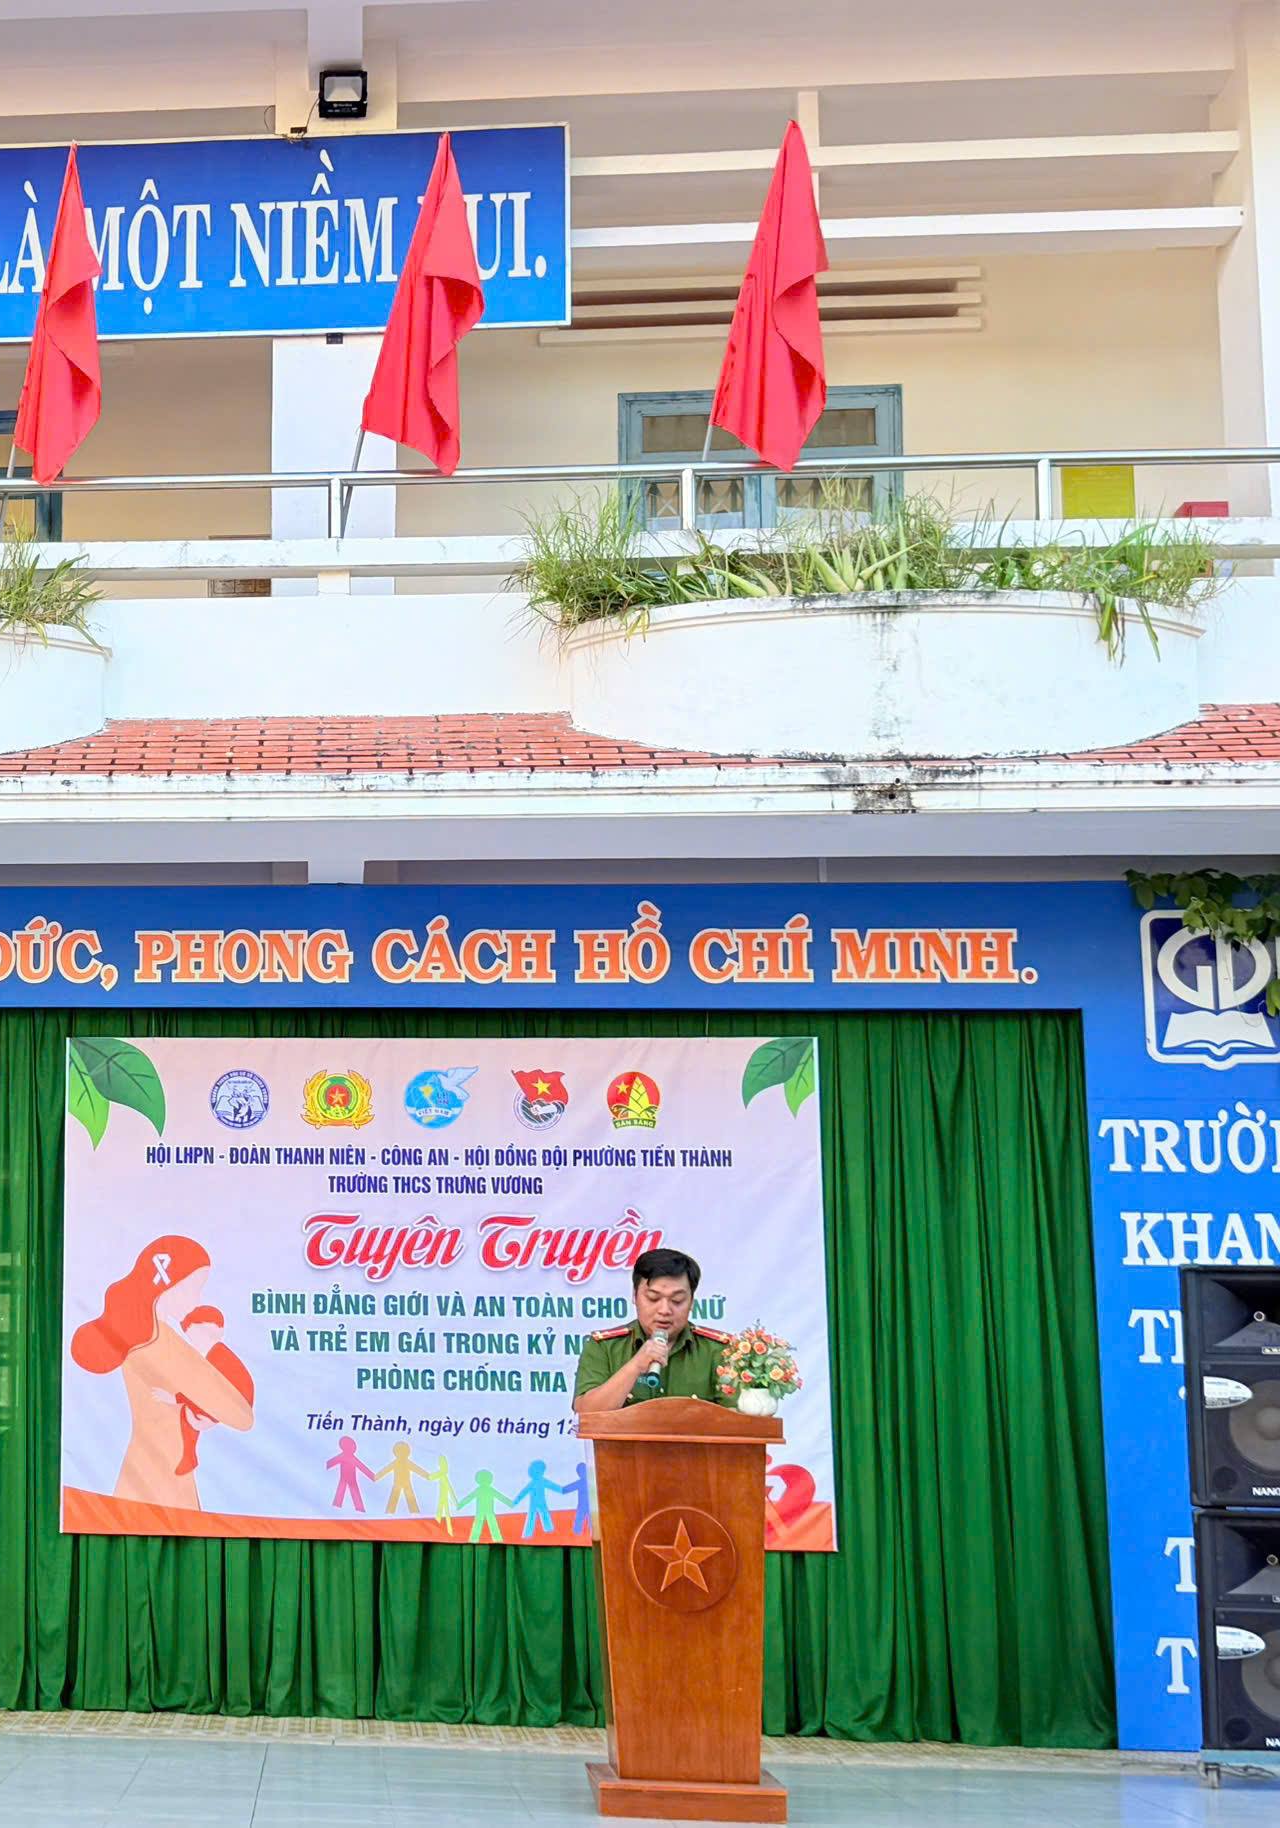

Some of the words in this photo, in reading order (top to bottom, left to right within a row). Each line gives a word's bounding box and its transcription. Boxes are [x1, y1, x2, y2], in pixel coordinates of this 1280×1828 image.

[229, 149, 398, 288] NIỀM
[417, 191, 547, 281] UI.
[134, 929, 354, 984] PHONG
[371, 914, 556, 984] CÁCH
[573, 900, 671, 985] HỒ
[688, 913, 814, 984] CHÍ
[830, 928, 1038, 984] MINH.
[146, 1143, 170, 1167] HỘI
[176, 1147, 214, 1165] LHPN
[229, 1144, 270, 1165] ĐOÀN
[275, 1147, 324, 1165] THANH
[329, 1143, 366, 1165] NIÊN
[381, 1145, 423, 1166] CÔNG
[427, 1148, 449, 1166] AN
[465, 1145, 489, 1170] HỘI
[494, 1143, 537, 1167] ĐỒNG
[542, 1145, 567, 1170] ĐỘI
[573, 1145, 636, 1167] PHƯỜNG
[641, 1144, 675, 1167] TIẾN
[680, 1145, 732, 1167] THÀNH
[328, 1172, 388, 1194] TRƯỜNG
[392, 1176, 431, 1194] THCS
[436, 1175, 486, 1194] TRƯNG
[491, 1175, 543, 1195] VƯƠNG
[303, 1213, 464, 1281] Tuyên
[480, 1208, 662, 1282] Truyền
[252, 1289, 305, 1314] BÌNH
[313, 1284, 375, 1315] ĐẲNG
[384, 1290, 428, 1316] GIỚI
[437, 1291, 465, 1316] VÀ
[473, 1296, 505, 1317] AN
[512, 1292, 573, 1318] TOÀN
[582, 1297, 628, 1318] CHO
[692, 1294, 726, 1320] NỮ
[270, 1325, 299, 1351] VÀ
[306, 1324, 347, 1351] TRẺ
[355, 1331, 389, 1352] EM
[398, 1328, 435, 1353] GÁI
[443, 1333, 519, 1354] TRONG
[528, 1327, 556, 1355] KỶ
[357, 1363, 435, 1390] PHÒNG
[443, 1363, 521, 1391] CHỐNG
[530, 1371, 567, 1392] MA
[307, 1410, 343, 1430] Tiến
[351, 1415, 412, 1434] Thành,
[419, 1416, 463, 1437] ngày
[470, 1417, 490, 1433] 06
[497, 1417, 550, 1438] tháng
